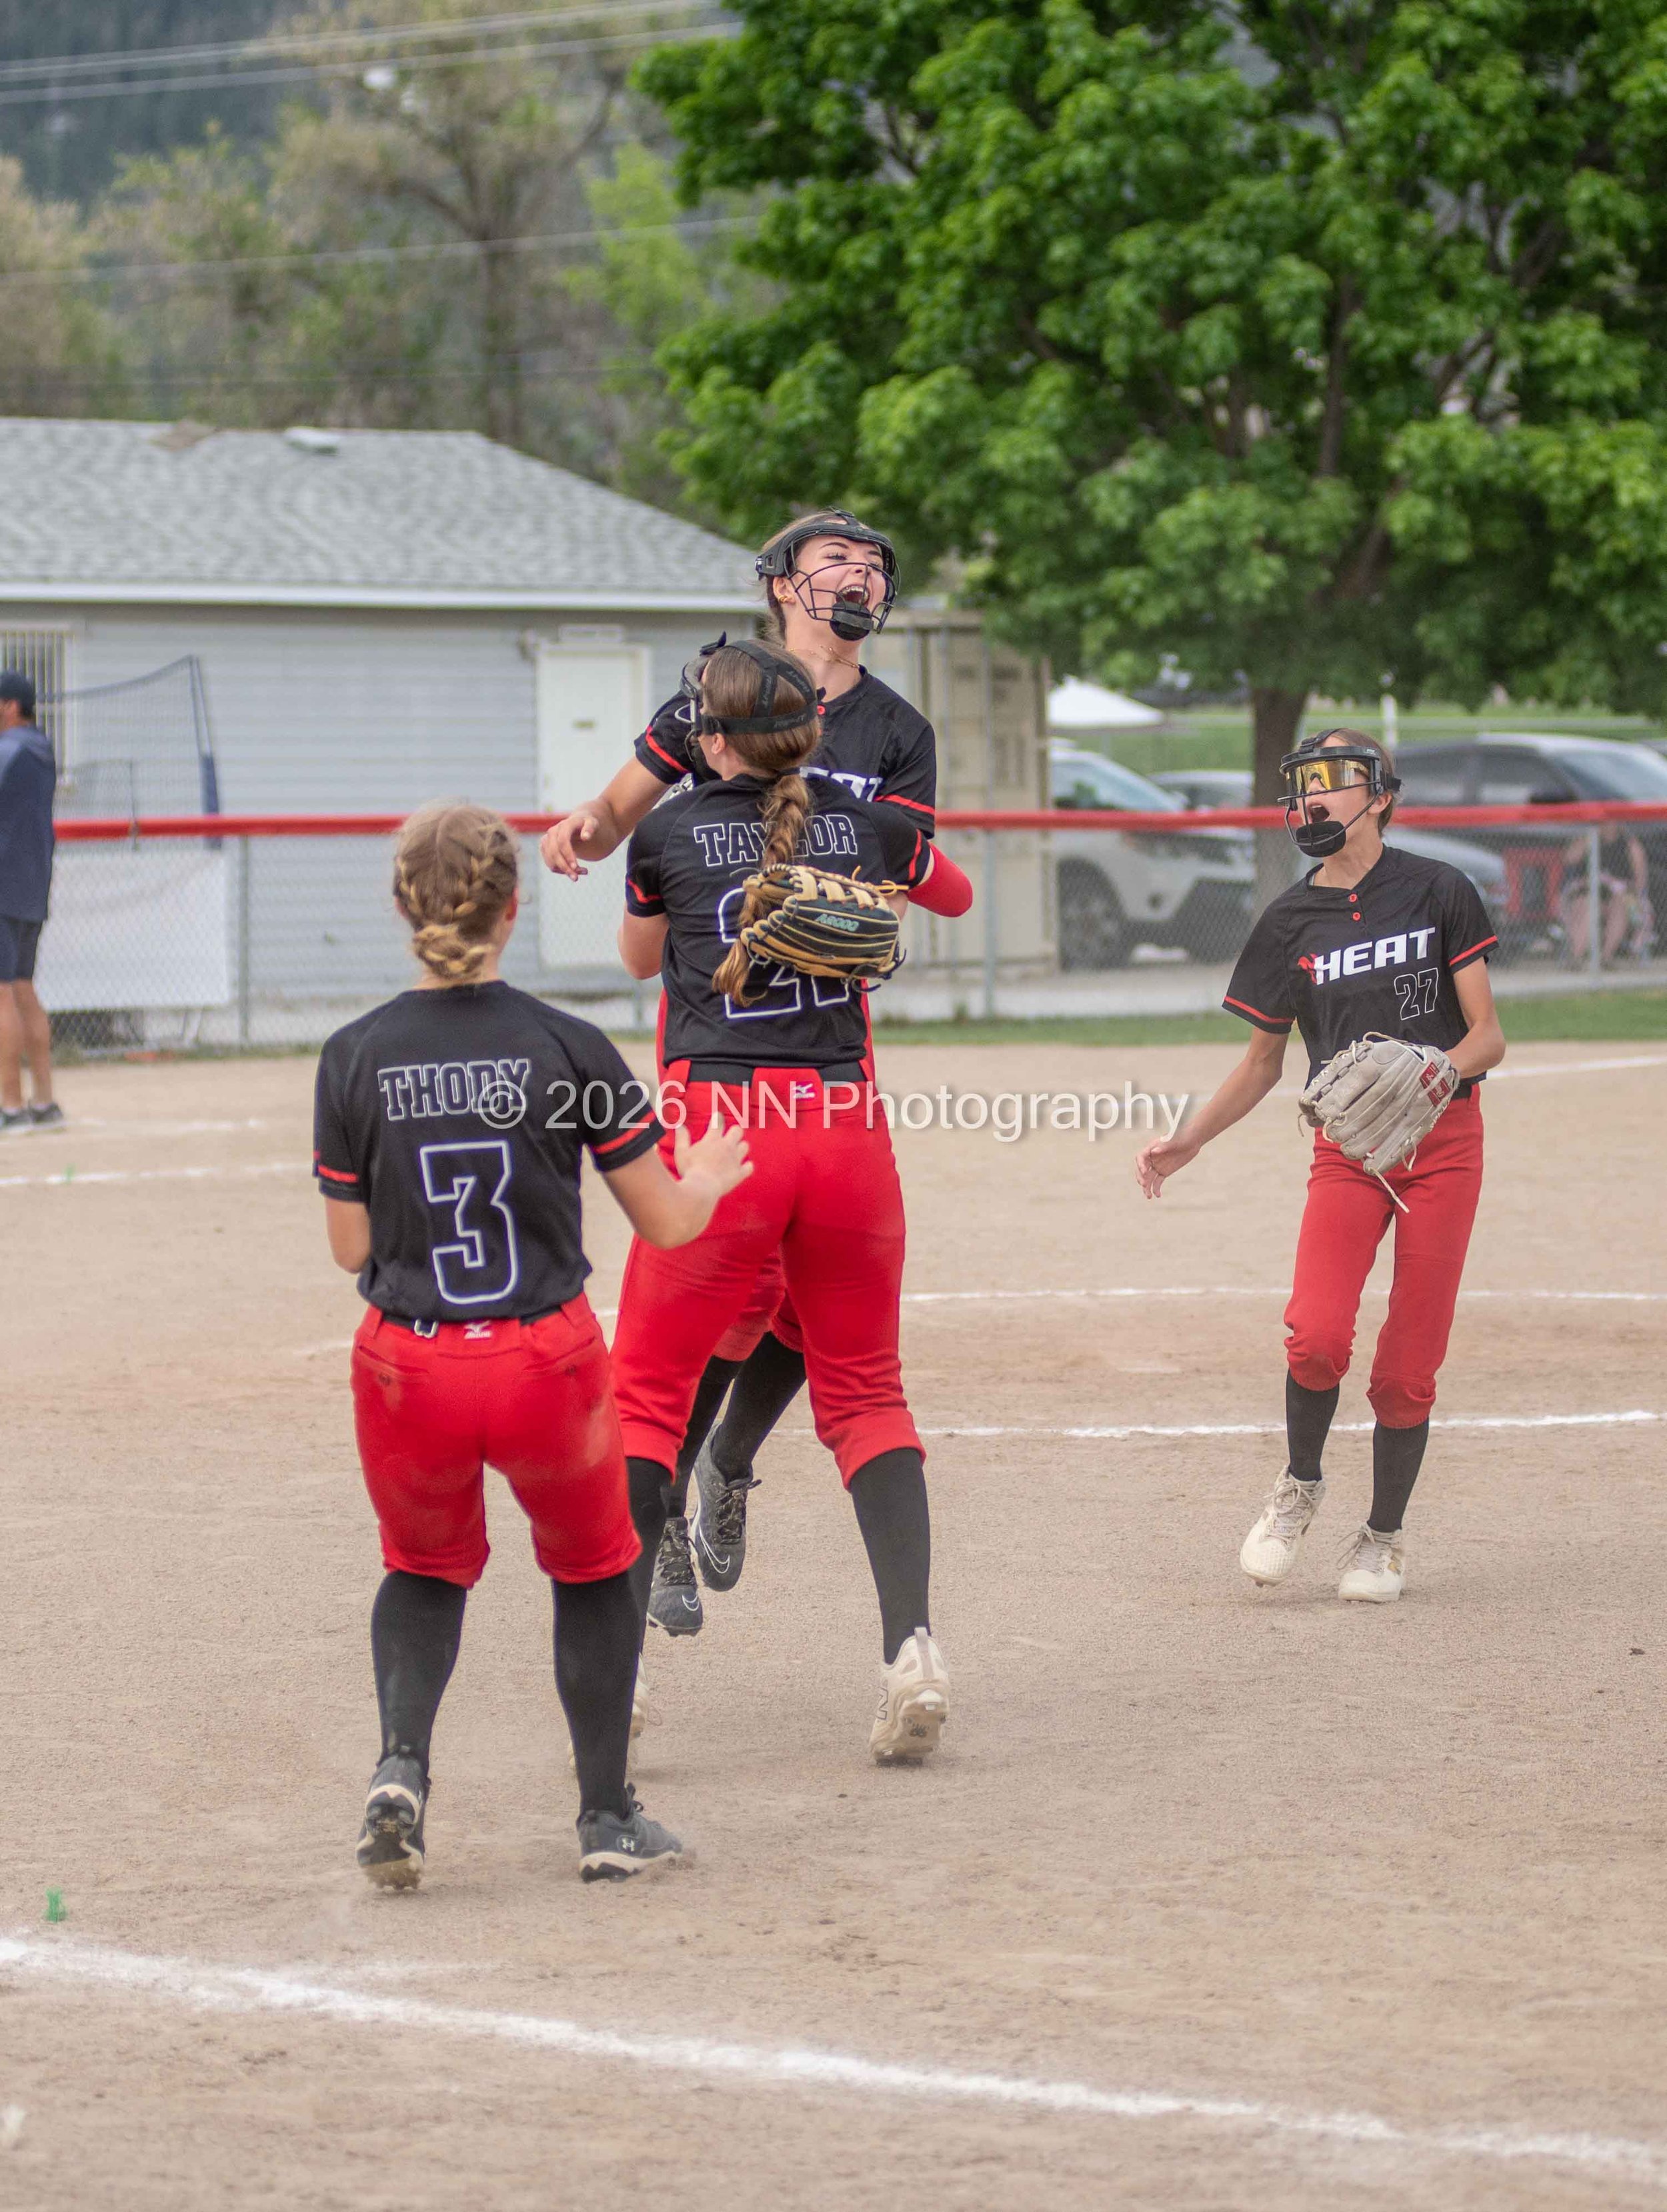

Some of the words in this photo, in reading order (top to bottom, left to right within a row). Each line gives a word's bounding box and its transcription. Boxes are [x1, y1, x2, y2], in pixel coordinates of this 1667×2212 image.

[1314, 927, 1436, 985] HEAT
[1394, 967, 1439, 1021] 27
[377, 1058, 531, 1121] THODY
[419, 1140, 518, 1305] 3
